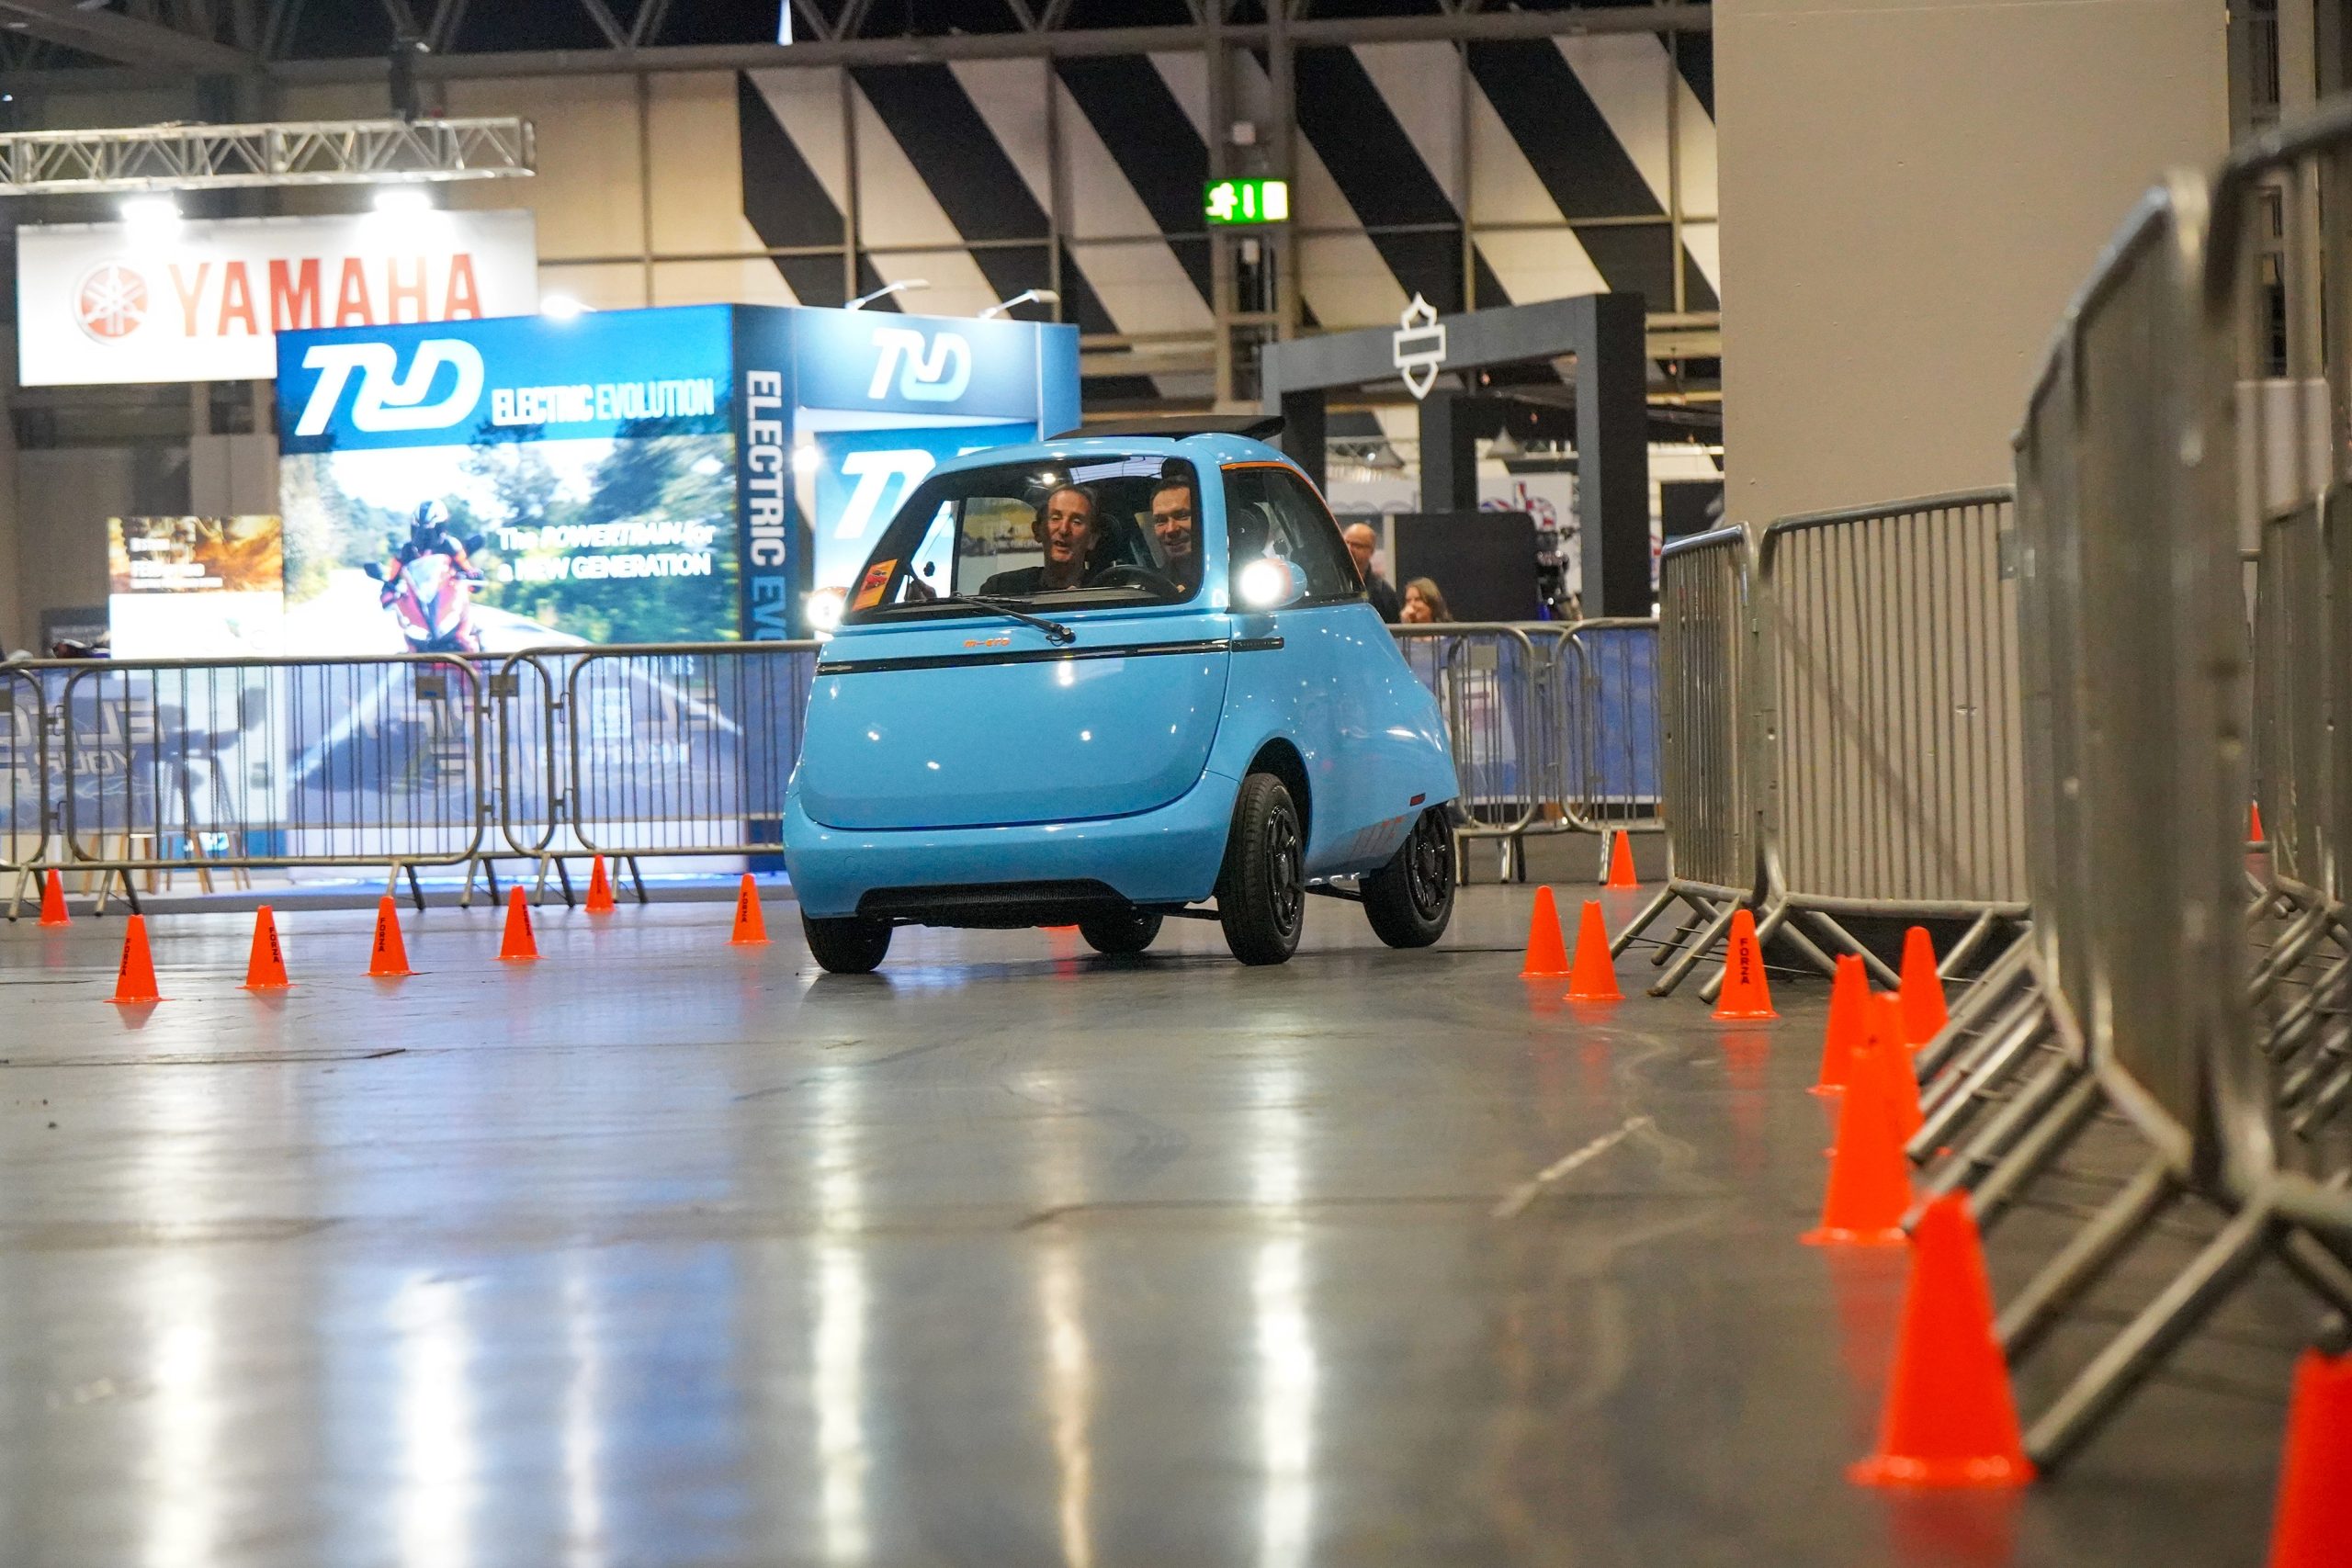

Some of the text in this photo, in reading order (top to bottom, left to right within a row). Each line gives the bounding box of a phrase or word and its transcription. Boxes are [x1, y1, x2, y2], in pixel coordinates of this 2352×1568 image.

[168, 253, 484, 337] YAMAHA
[492, 378, 715, 426] ELECTRIC EVOLUTION
[746, 369, 786, 567] ELECTRIC
[496, 527, 539, 550] The
[497, 553, 711, 582] a NEW GENERATION
[120, 937, 131, 976] FORZA
[268, 926, 280, 963] FORZA
[1740, 937, 1750, 986] FORZA
